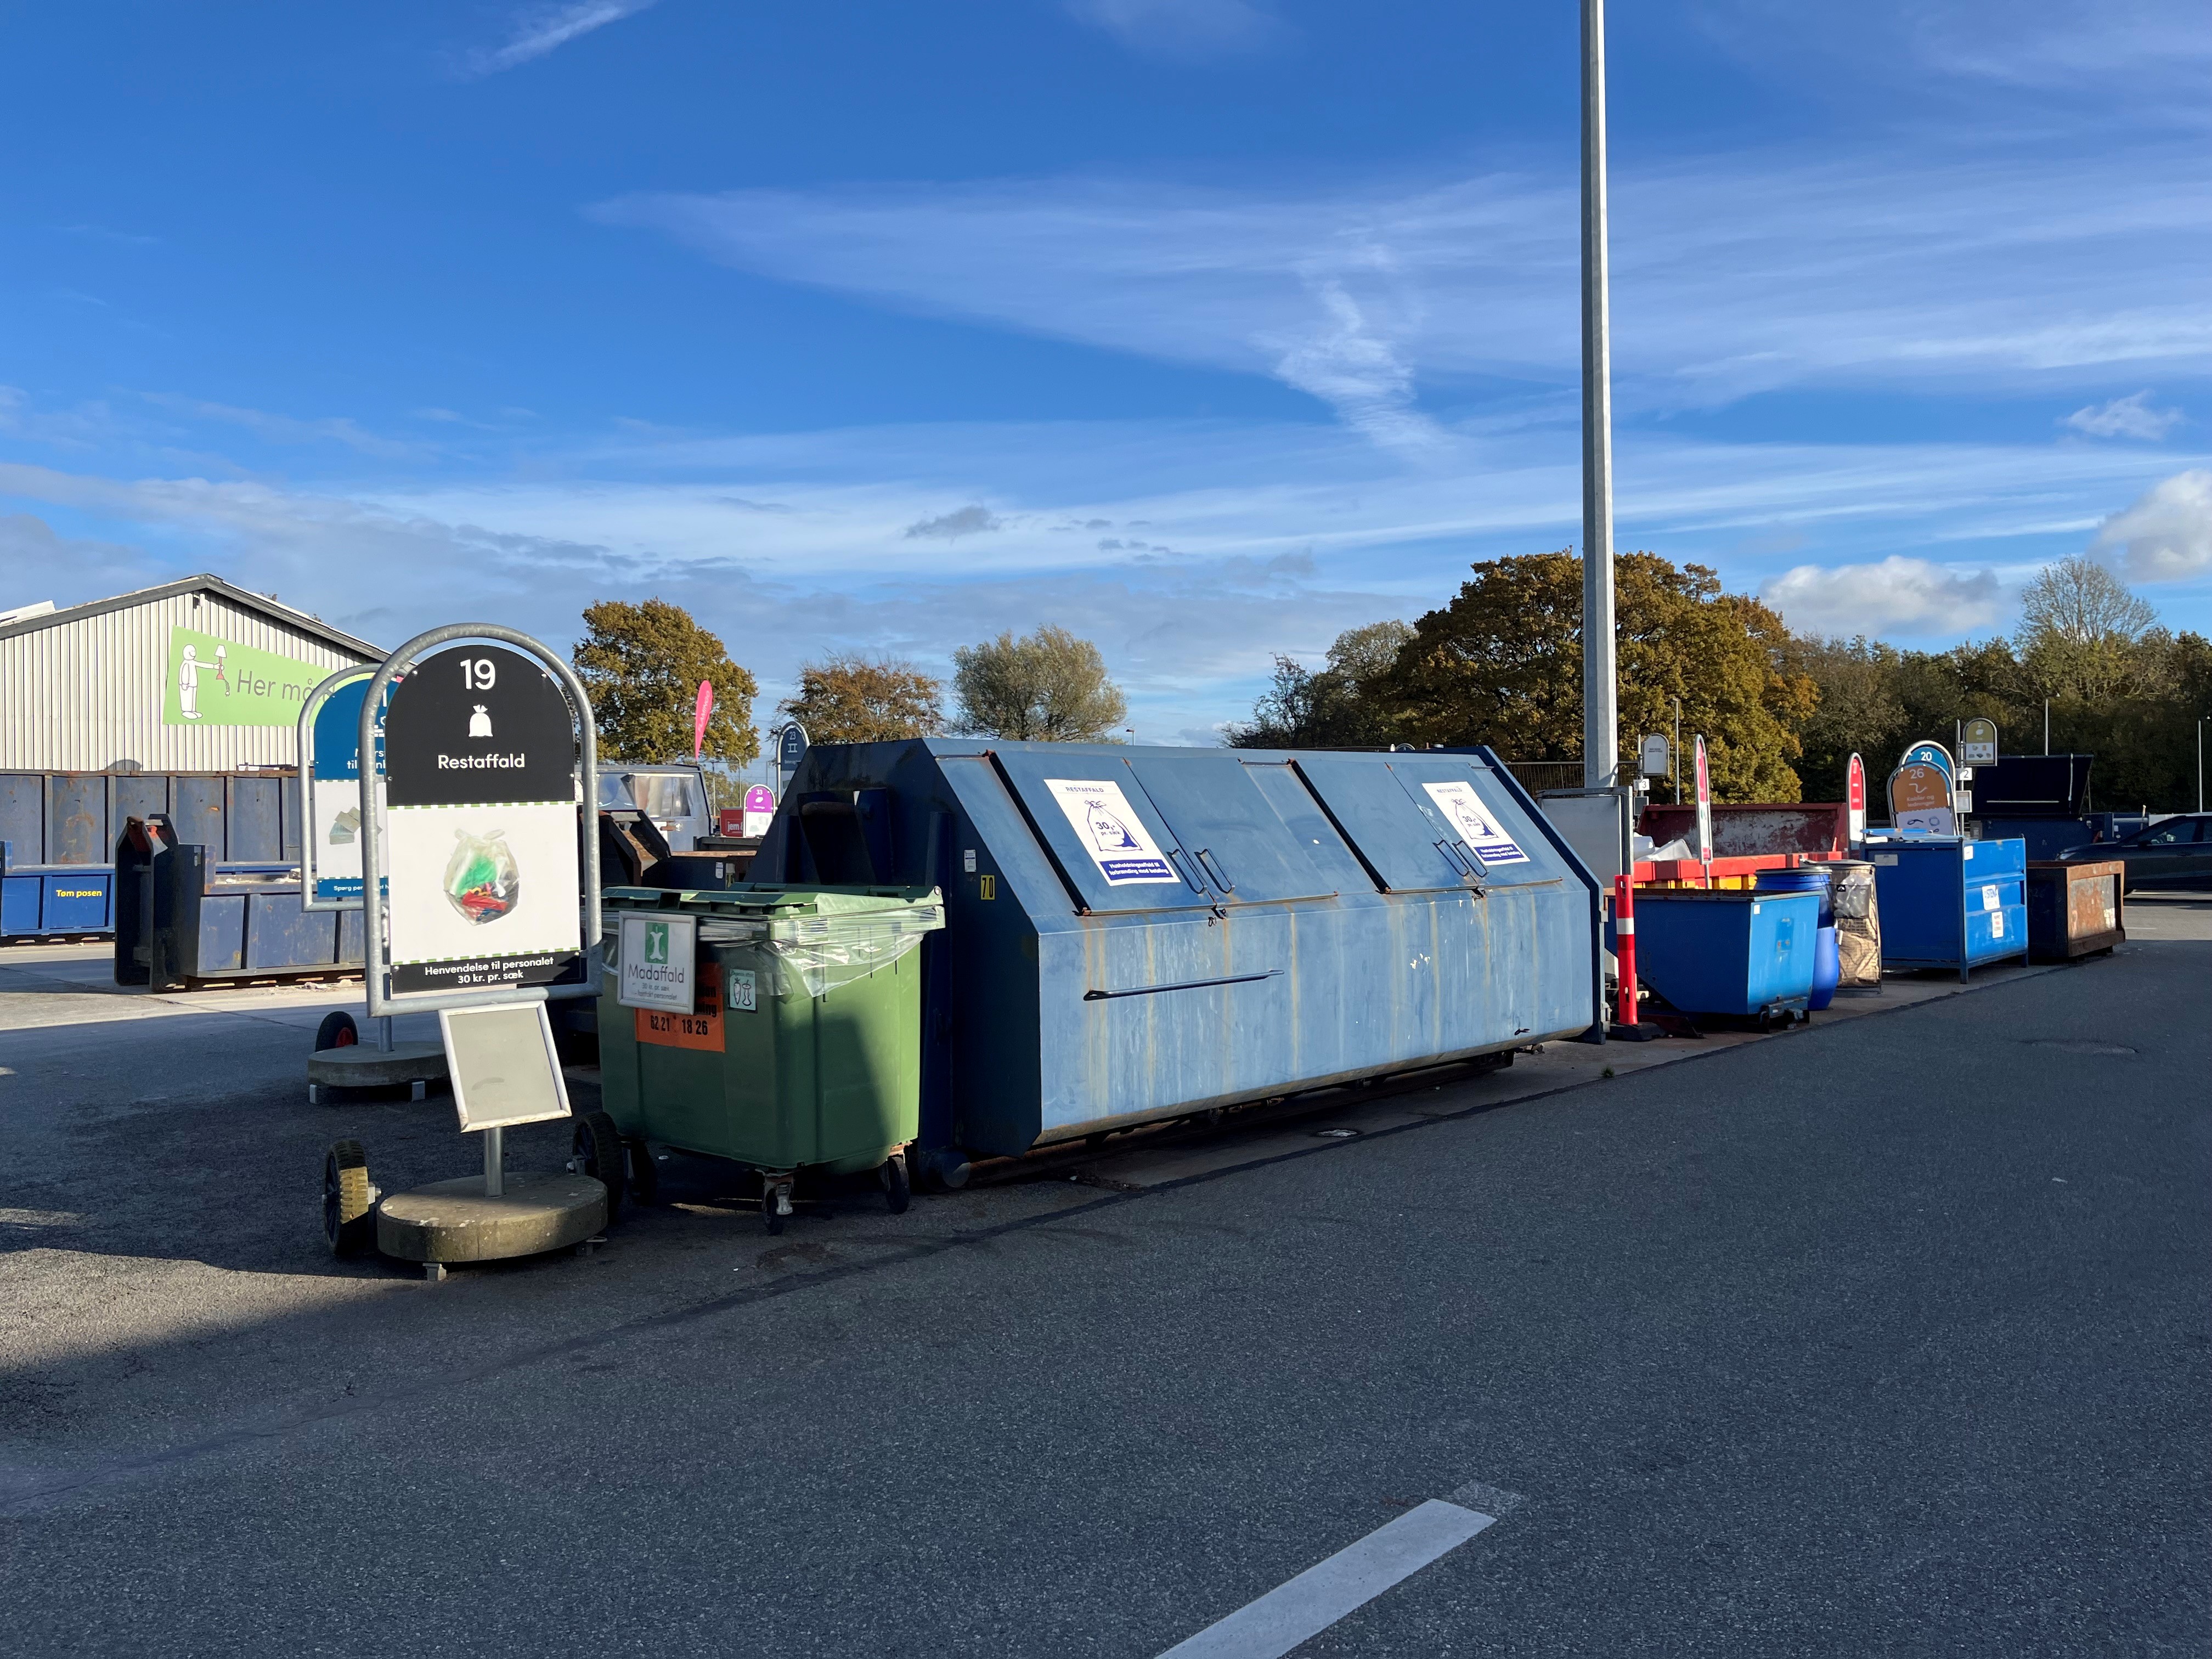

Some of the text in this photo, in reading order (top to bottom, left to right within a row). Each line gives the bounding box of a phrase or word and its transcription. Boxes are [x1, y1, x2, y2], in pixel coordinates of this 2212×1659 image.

[460, 659, 495, 690] 19
[237, 669, 276, 697] Her
[789, 731, 797, 740] 23
[438, 753, 525, 769] Restaffald
[1921, 752, 1932, 761] 20
[1909, 768, 1924, 779] 26
[1963, 770, 1969, 778] 2
[727, 821, 739, 832] jem
[1096, 821, 1115, 831] 30,-
[982, 877, 994, 898] 70
[425, 957, 554, 976] Henvendelse til personalet
[628, 963, 684, 983] Madaffald
[458, 969, 524, 984] 30 kr. pr. sæk
[661, 1017, 670, 1031] 21
[681, 1019, 692, 1034] 18
[695, 1020, 708, 1035] 26
